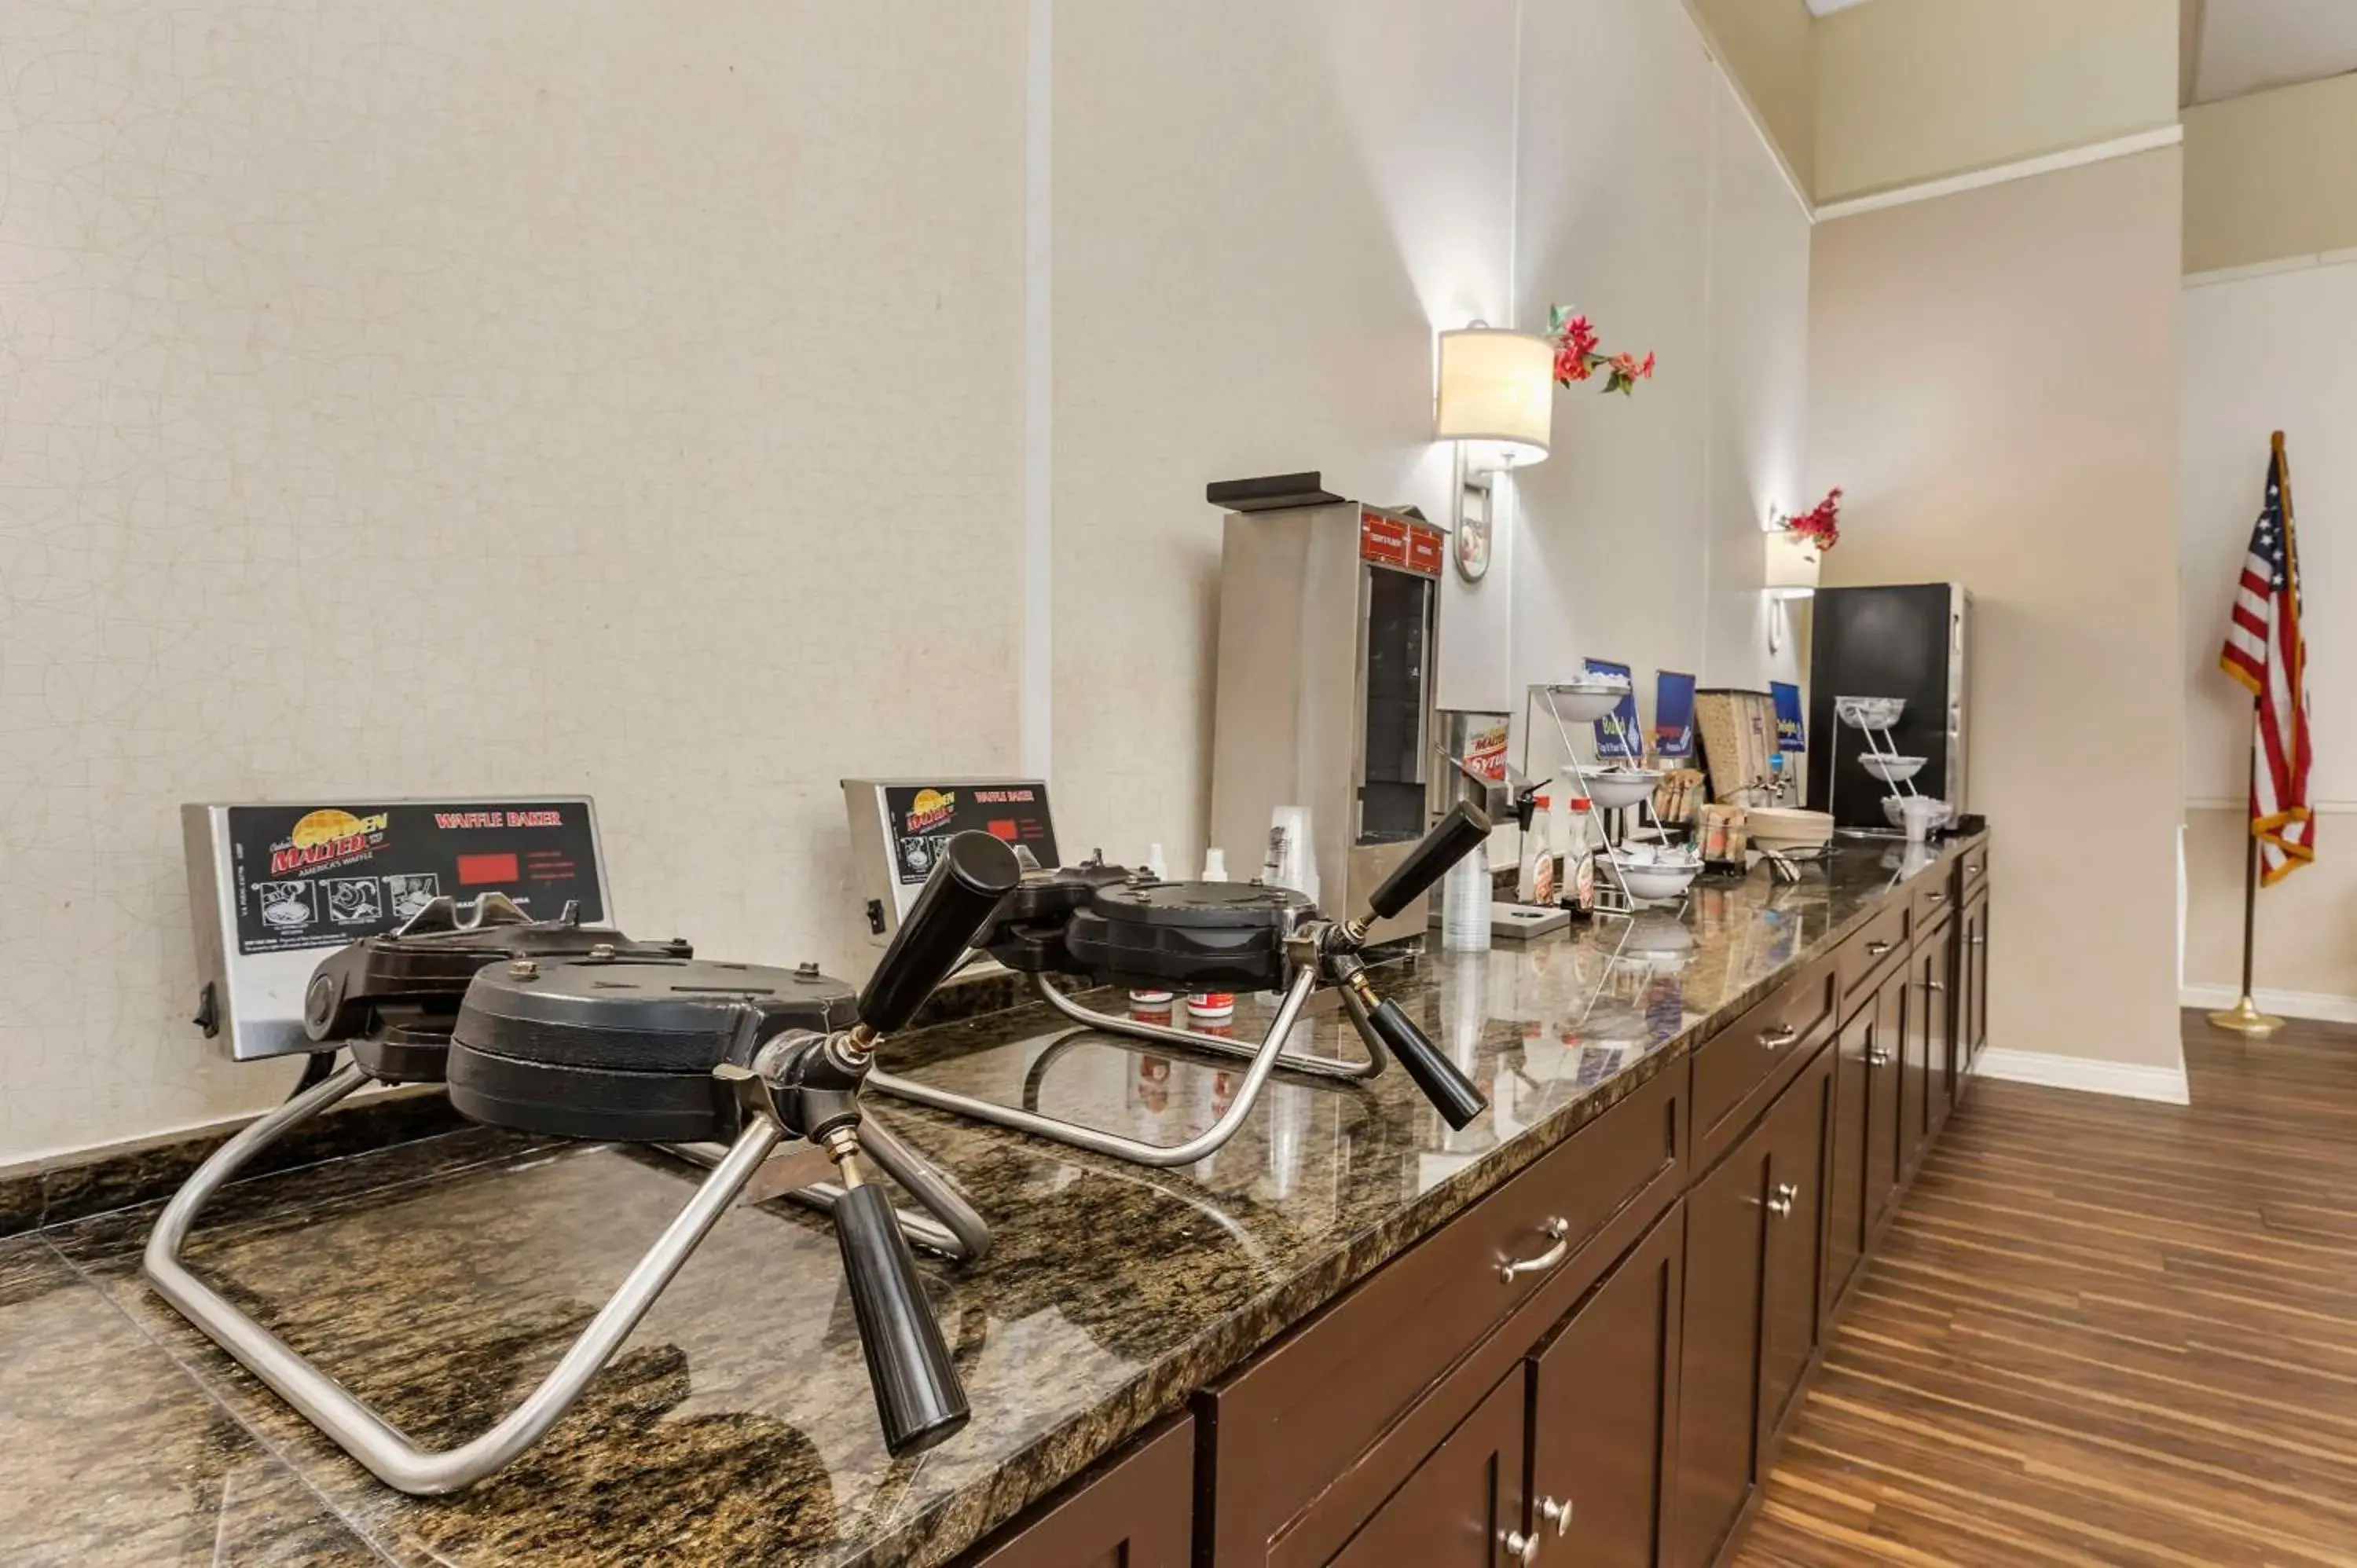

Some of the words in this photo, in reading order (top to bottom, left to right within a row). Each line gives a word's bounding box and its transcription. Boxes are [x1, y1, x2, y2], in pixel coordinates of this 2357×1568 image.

[434, 811, 504, 829] WAFFLE
[506, 811, 563, 827] BAKER
[271, 832, 367, 874] MALTED
